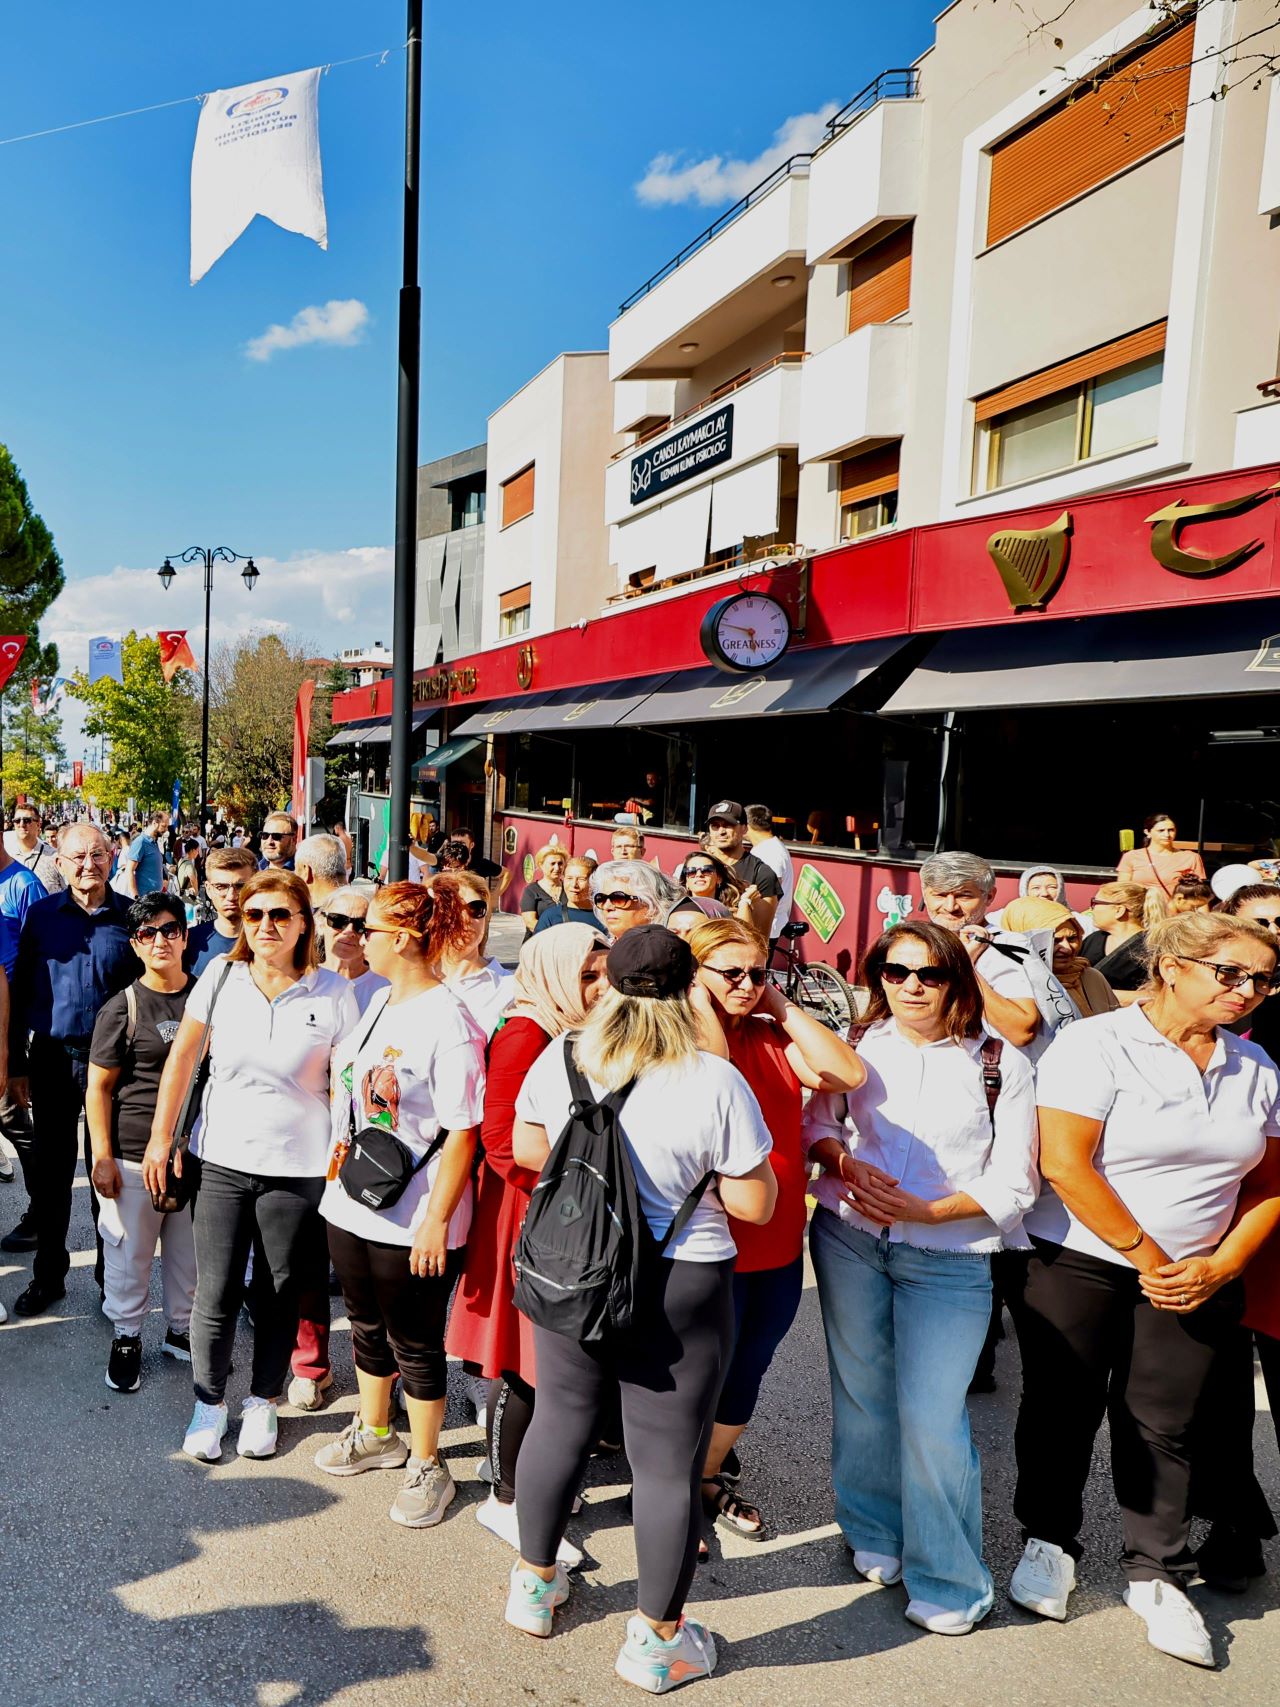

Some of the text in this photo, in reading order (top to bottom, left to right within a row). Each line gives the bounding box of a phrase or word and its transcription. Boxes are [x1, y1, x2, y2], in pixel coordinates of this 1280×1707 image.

[652, 441, 677, 466] CANSU
[715, 413, 728, 433] AY
[660, 462, 680, 482] UZMAN
[722, 639, 776, 650] GREATNESS
